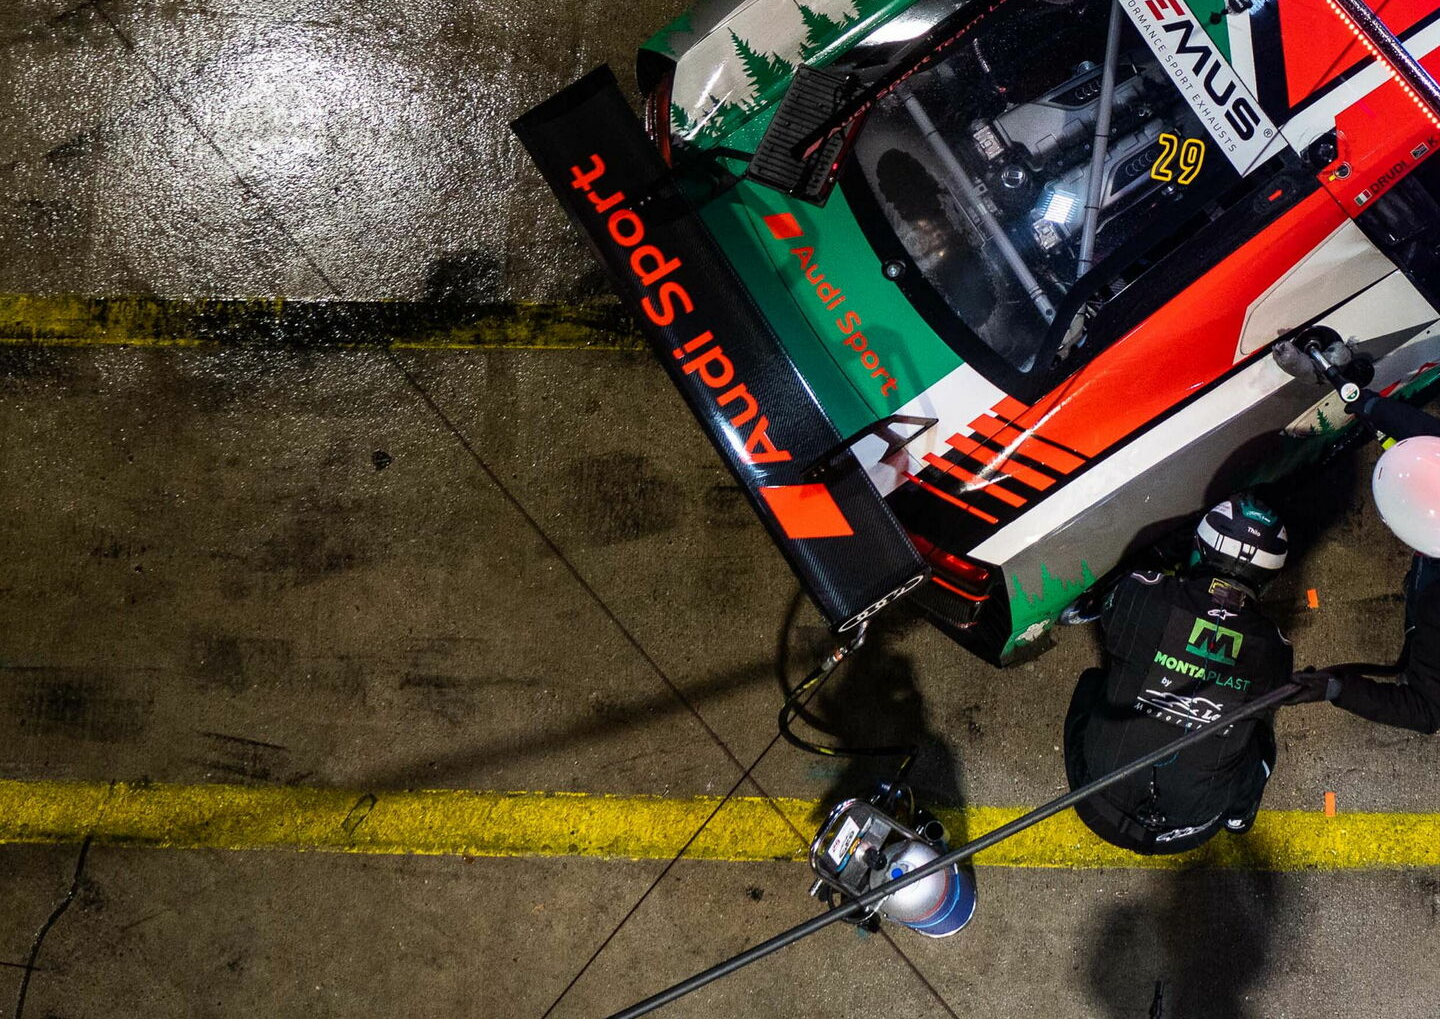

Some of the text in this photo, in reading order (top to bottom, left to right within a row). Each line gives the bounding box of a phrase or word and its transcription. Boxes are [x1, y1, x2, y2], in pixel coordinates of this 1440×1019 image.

[935, 14, 985, 52] Team
[1165, 54, 1193, 90] SPORT
[1192, 93, 1237, 153] EXHAUSTS
[1150, 132, 1206, 185] 29
[1370, 160, 1409, 194] DRUDI
[570, 154, 792, 465] Audi Sport
[790, 246, 898, 397] Audi Sport
[1153, 651, 1250, 692] MONTAPLAST
[1161, 677, 1172, 688] by
